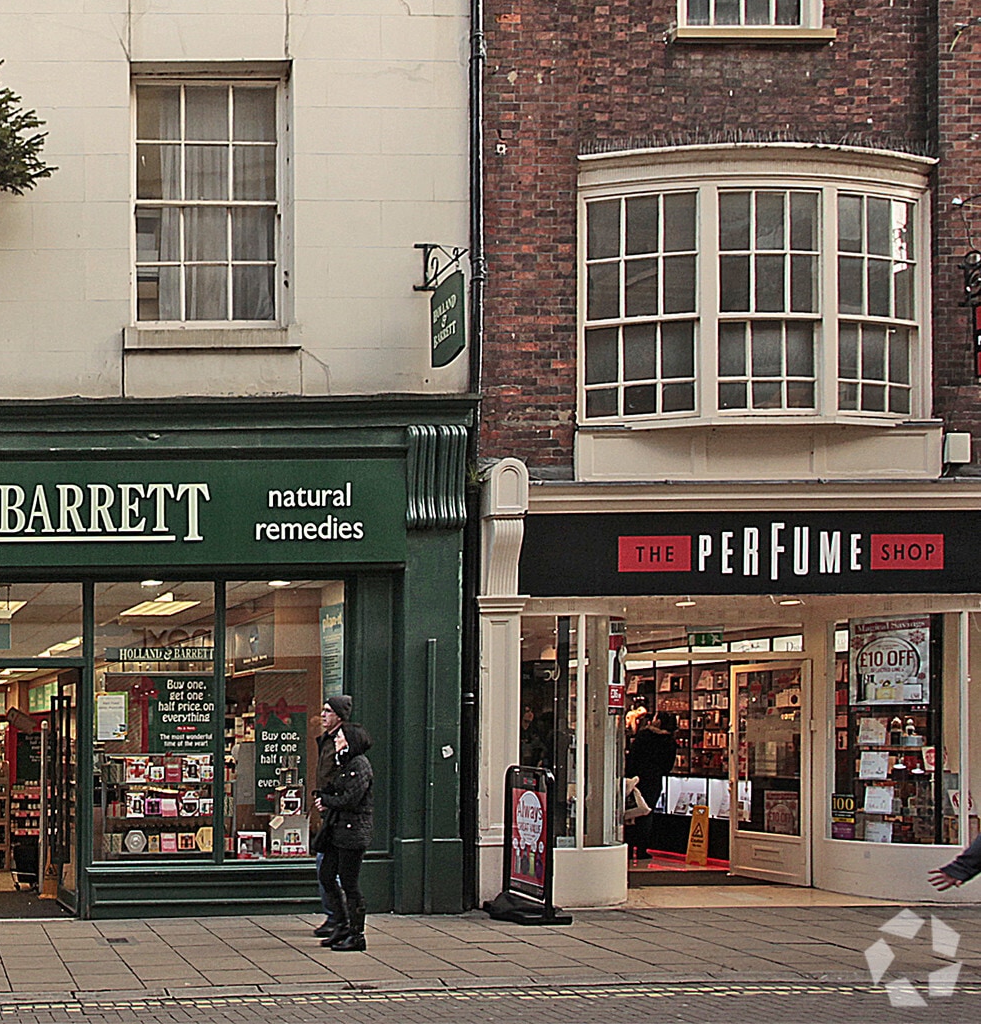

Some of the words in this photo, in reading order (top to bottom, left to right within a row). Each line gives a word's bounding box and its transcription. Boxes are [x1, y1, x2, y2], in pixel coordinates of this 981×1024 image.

[433, 294, 457, 324] HOLLAND
[433, 320, 457, 349] BARRETT
[268, 482, 352, 508] natural
[255, 516, 364, 540] remedies
[635, 546, 675, 562] THE
[698, 522, 861, 580] PERFUME
[881, 543, 935, 561] SHOP
[857, 622, 889, 632] Magical
[891, 620, 925, 629] Savings
[120, 648, 162, 661] HOLLAND
[163, 649, 173, 660] &
[860, 650, 883, 667] £10
[887, 649, 915, 667] OFF
[167, 679, 184, 690] Buy
[169, 692, 184, 701] get
[188, 692, 203, 700] one
[158, 702, 175, 711] half
[203, 703, 214, 711] on
[162, 712, 210, 723] everything
[261, 731, 278, 741] Buy
[264, 743, 278, 752] get
[281, 744, 297, 752] one
[260, 755, 277, 764] half
[833, 798, 854, 810] 100
[517, 800, 542, 823] Always
